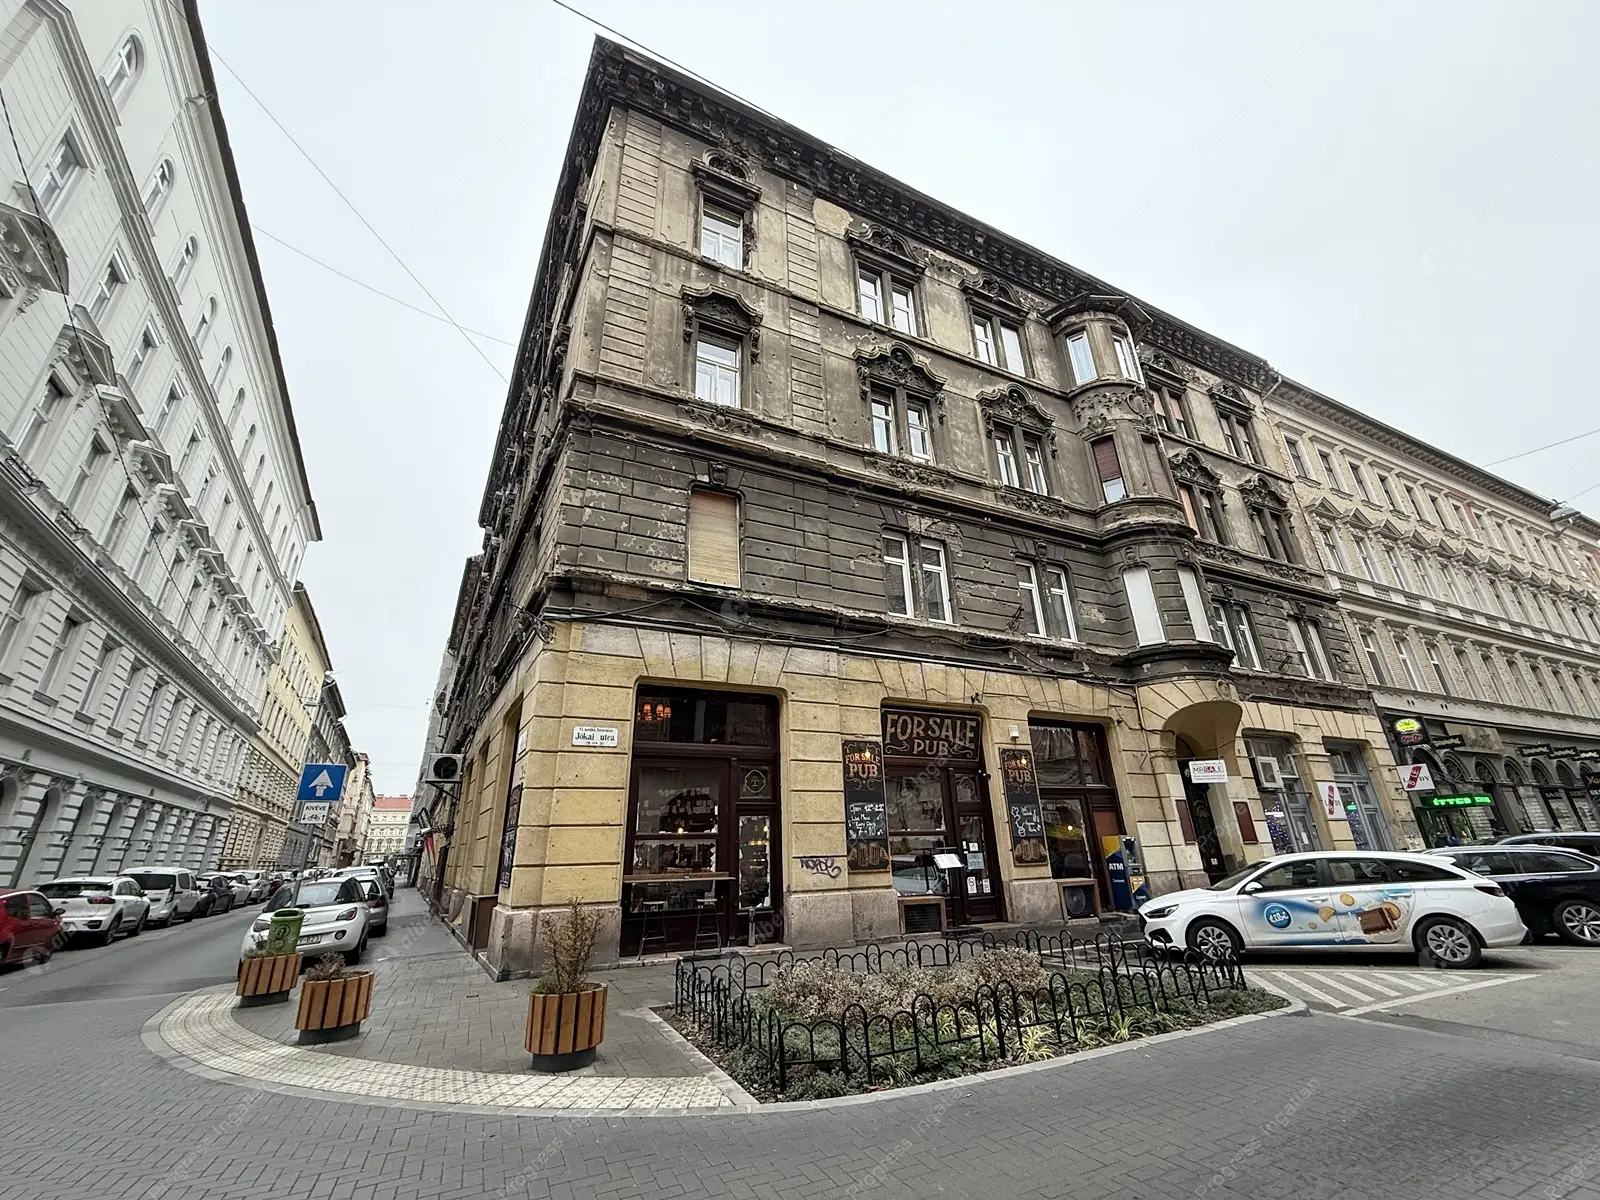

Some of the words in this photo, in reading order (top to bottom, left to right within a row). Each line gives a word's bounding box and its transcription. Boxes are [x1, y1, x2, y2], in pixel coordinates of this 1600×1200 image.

[884, 714, 926, 744] FOR
[927, 716, 976, 749] SALE
[912, 739, 949, 756] PUB
[845, 753, 861, 764] FOR
[860, 752, 880, 766] SLE
[849, 763, 878, 778] PUB
[1008, 769, 1031, 782] PUB
[1108, 862, 1125, 871] ATM
